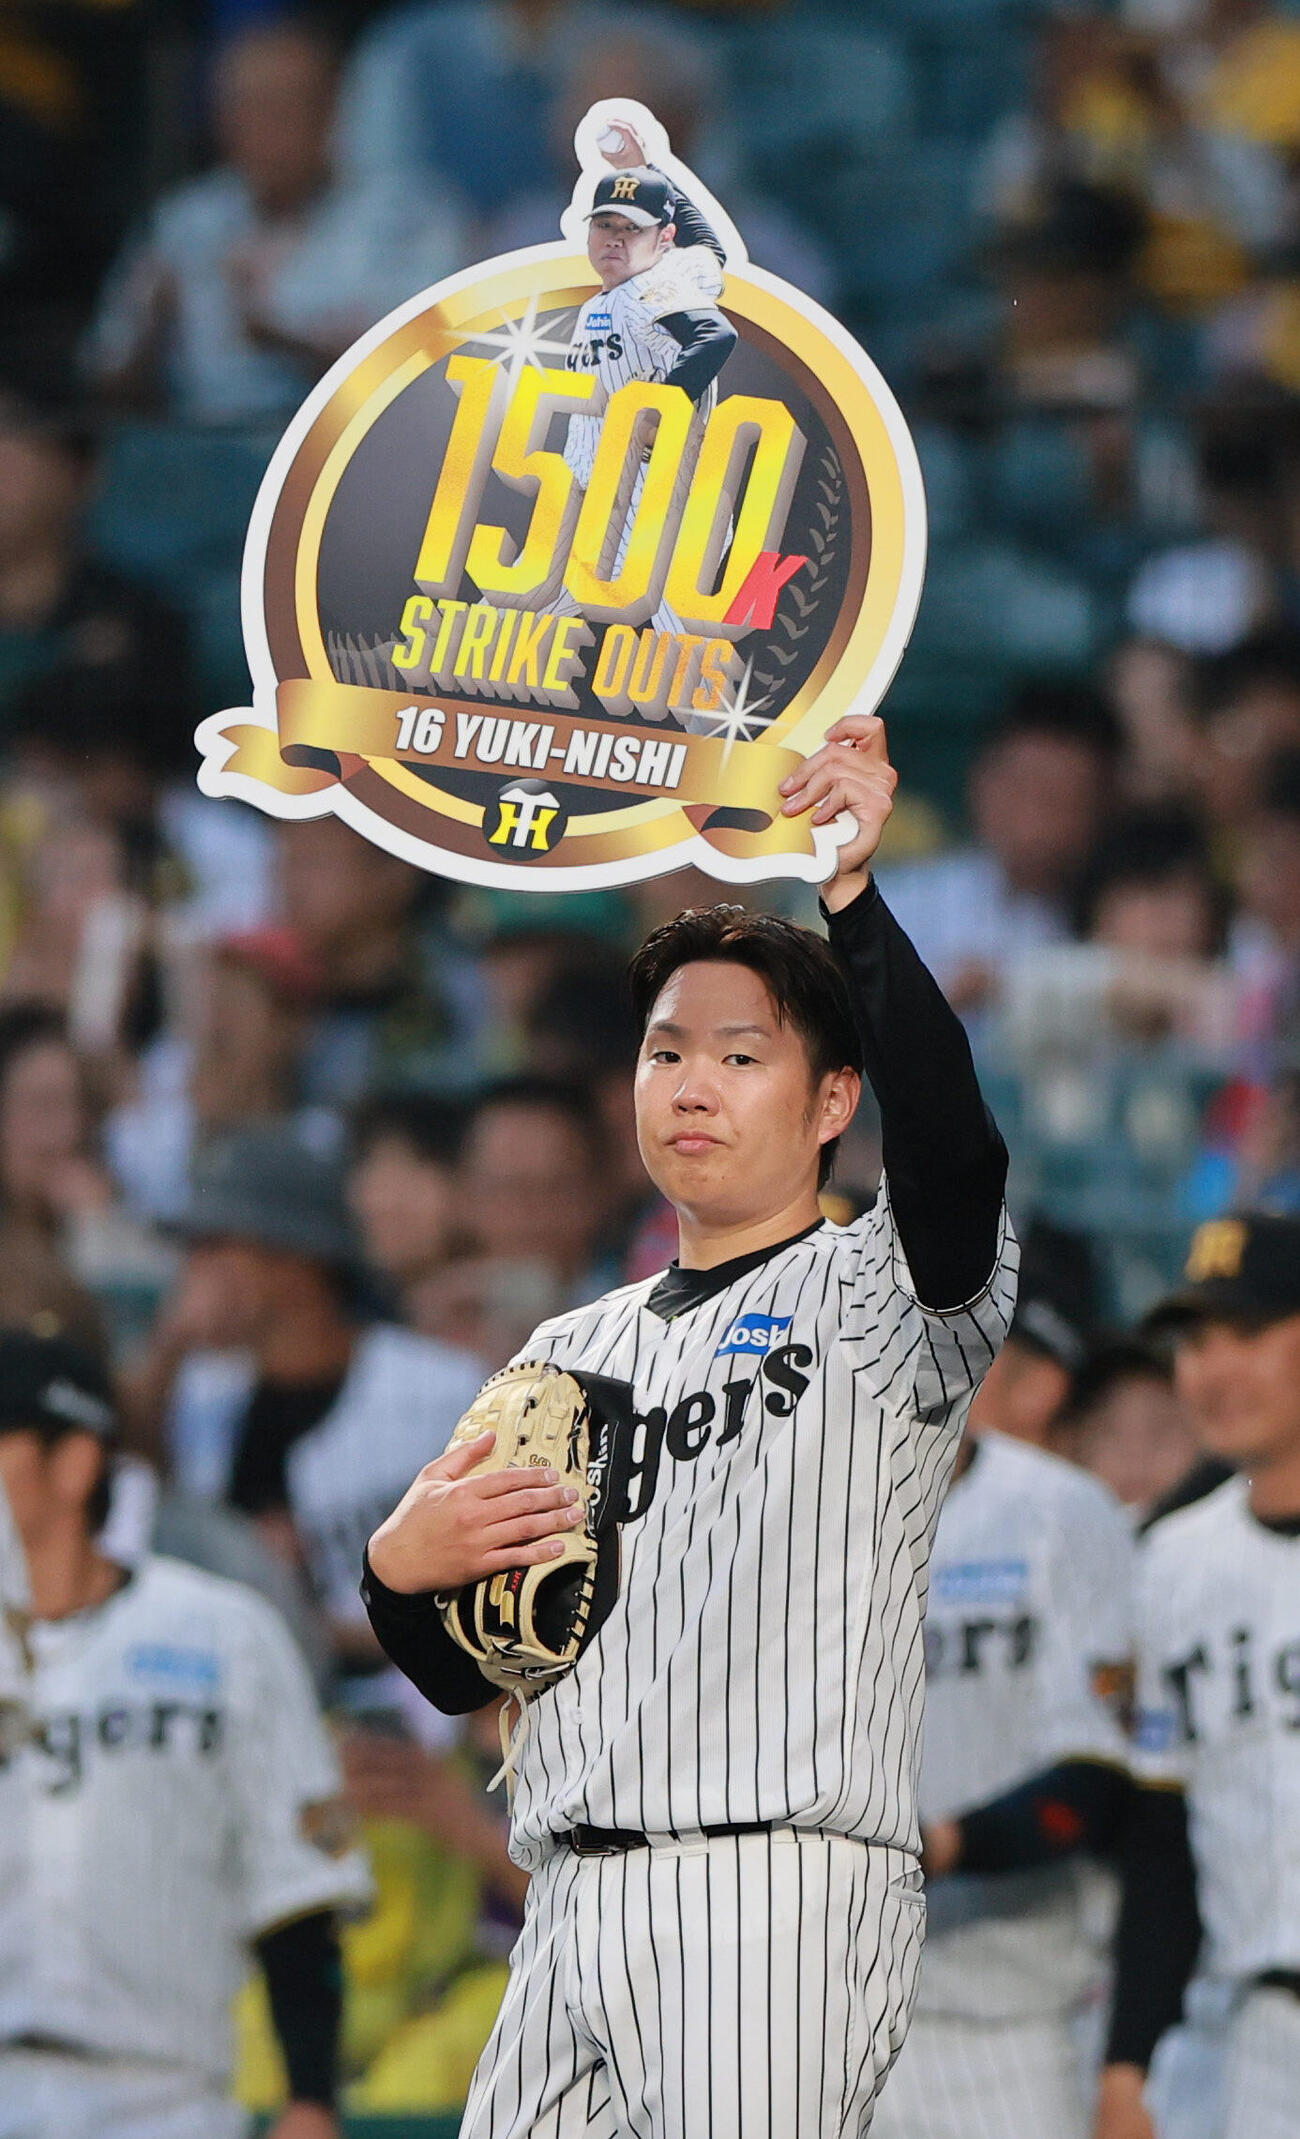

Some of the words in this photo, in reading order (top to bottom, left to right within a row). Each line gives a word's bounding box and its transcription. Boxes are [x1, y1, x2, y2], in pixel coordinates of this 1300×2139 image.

[414, 354, 797, 626] 1500
[391, 595, 588, 693] STRIKE
[591, 623, 738, 710] OUTS
[395, 706, 447, 755] 16
[454, 712, 688, 790] YUKI-NISHI
